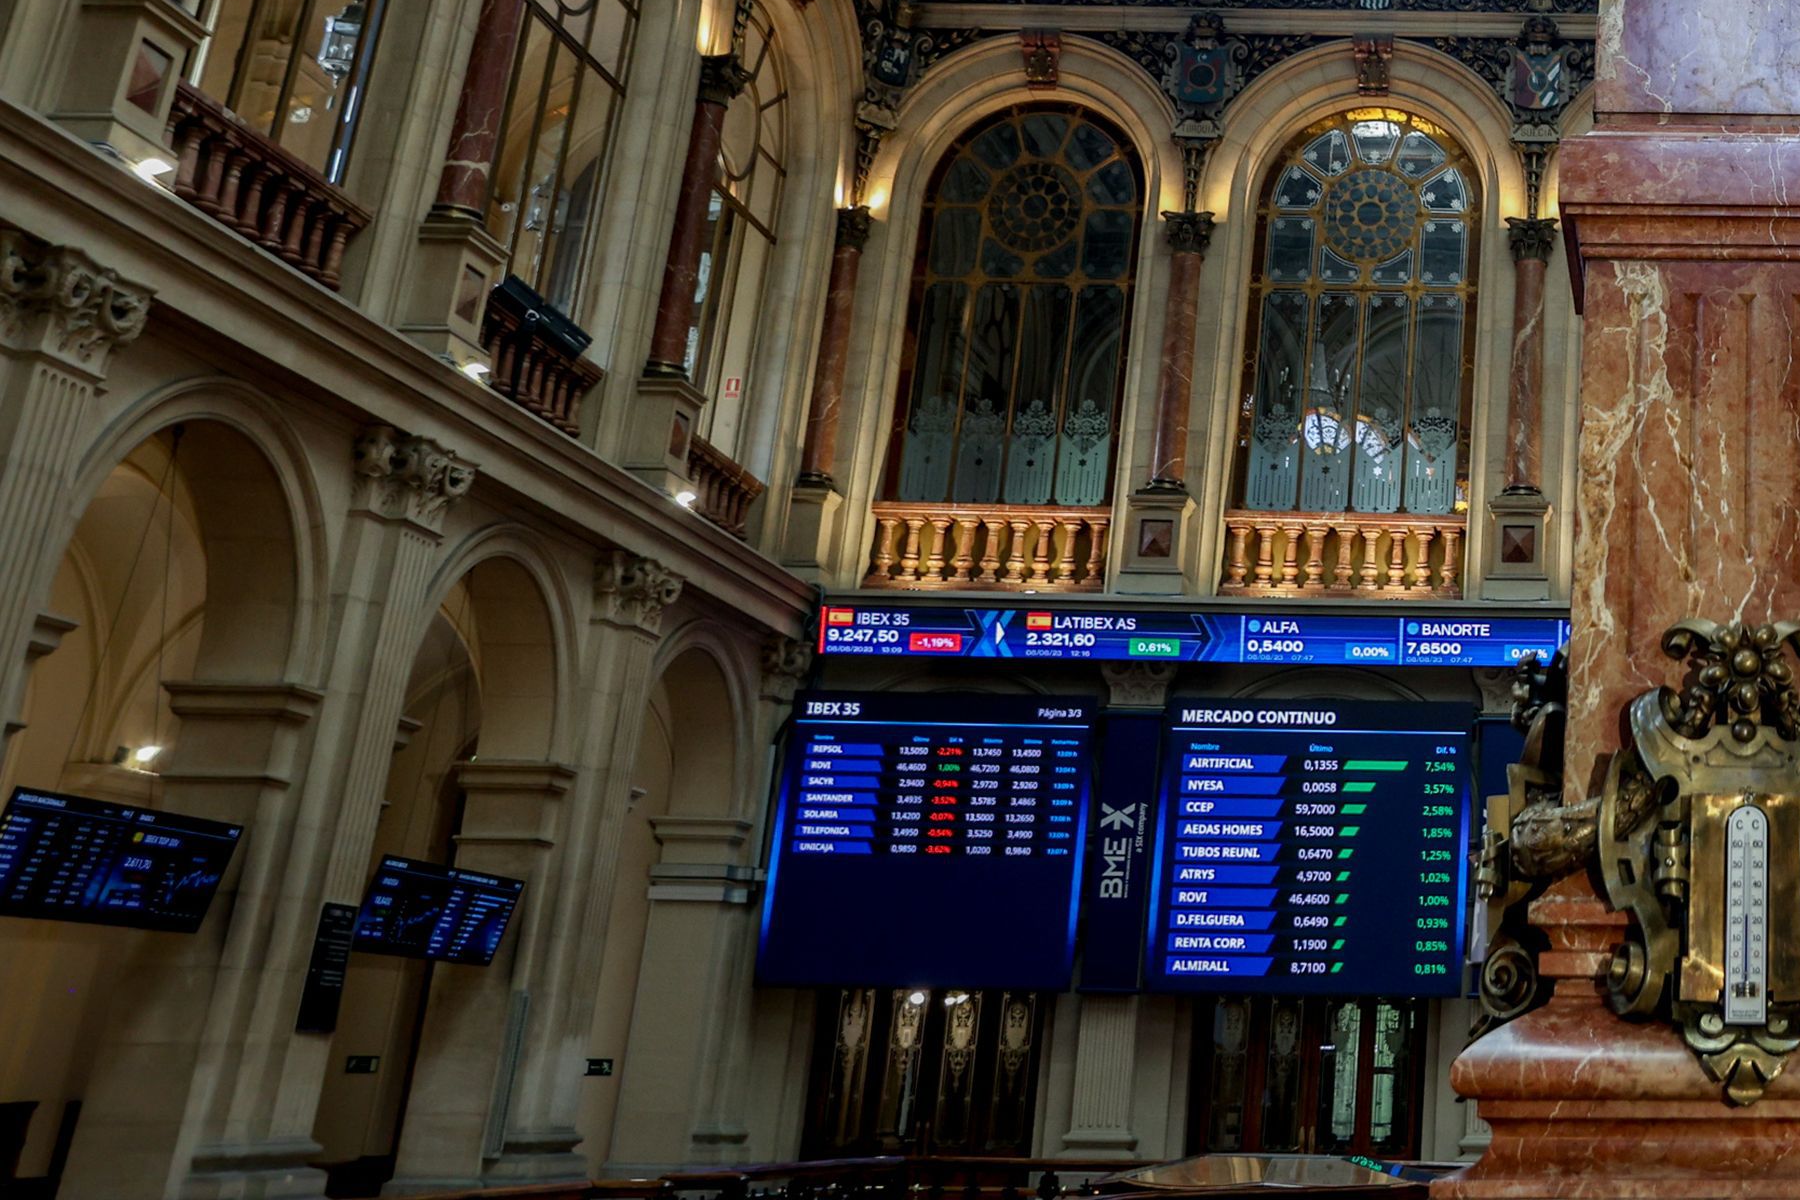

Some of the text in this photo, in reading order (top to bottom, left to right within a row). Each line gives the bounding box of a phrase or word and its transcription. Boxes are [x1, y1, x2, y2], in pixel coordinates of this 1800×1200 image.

[857, 613, 910, 625] IBEX 35
[1054, 617, 1136, 630] LATIBEX AS
[1263, 622, 1299, 634] ALFA
[1422, 624, 1490, 636] BANORTE
[827, 629, 954, 649] 9.247,50 -1,19%
[1026, 634, 1171, 653] 2.321,60 0,61%
[1248, 640, 1389, 658] 0,5400 0,00%
[1407, 642, 1461, 655] 7,6500
[807, 702, 1082, 719] IBEX 35 Página 3/3
[1182, 710, 1336, 725] MERCADO CONTINUO
[813, 745, 842, 753] REPSOL
[1191, 743, 1220, 751] Nombre
[811, 761, 831, 769] ROVI
[1189, 758, 1455, 772] AIRTIFICIAL 0,1355 7,54%
[808, 777, 833, 785] SACYR
[1188, 780, 1454, 794] NYESA 0,0058 3,57%
[806, 793, 853, 802] SANTANDER
[804, 810, 838, 819] SOLARIA
[1186, 802, 1453, 816] CCEP 59,7000 2,58%
[1137, 802, 1148, 835] company
[1736, 819, 1759, 830] C C
[802, 826, 849, 835] TELEFONICA
[1184, 824, 1452, 838] AEDAS HOMES 16,5000 1,85%
[800, 843, 834, 852] UNICAJA
[1183, 847, 1451, 861] TUBOS REUNI. 0,6470 1,25%
[1099, 837, 1127, 898] BME
[1180, 869, 1450, 883] ATRYS 4,9700 1,02%
[1179, 892, 1449, 906] ROVI 46,4600 1,00%
[1177, 915, 1448, 928] D.FELGUERA 0,6490 0,93%
[1175, 937, 1447, 951] RENTA CORP. 1,1900 0,85%
[1172, 960, 1446, 975] ALMIRALL 8,7100 0,81%
